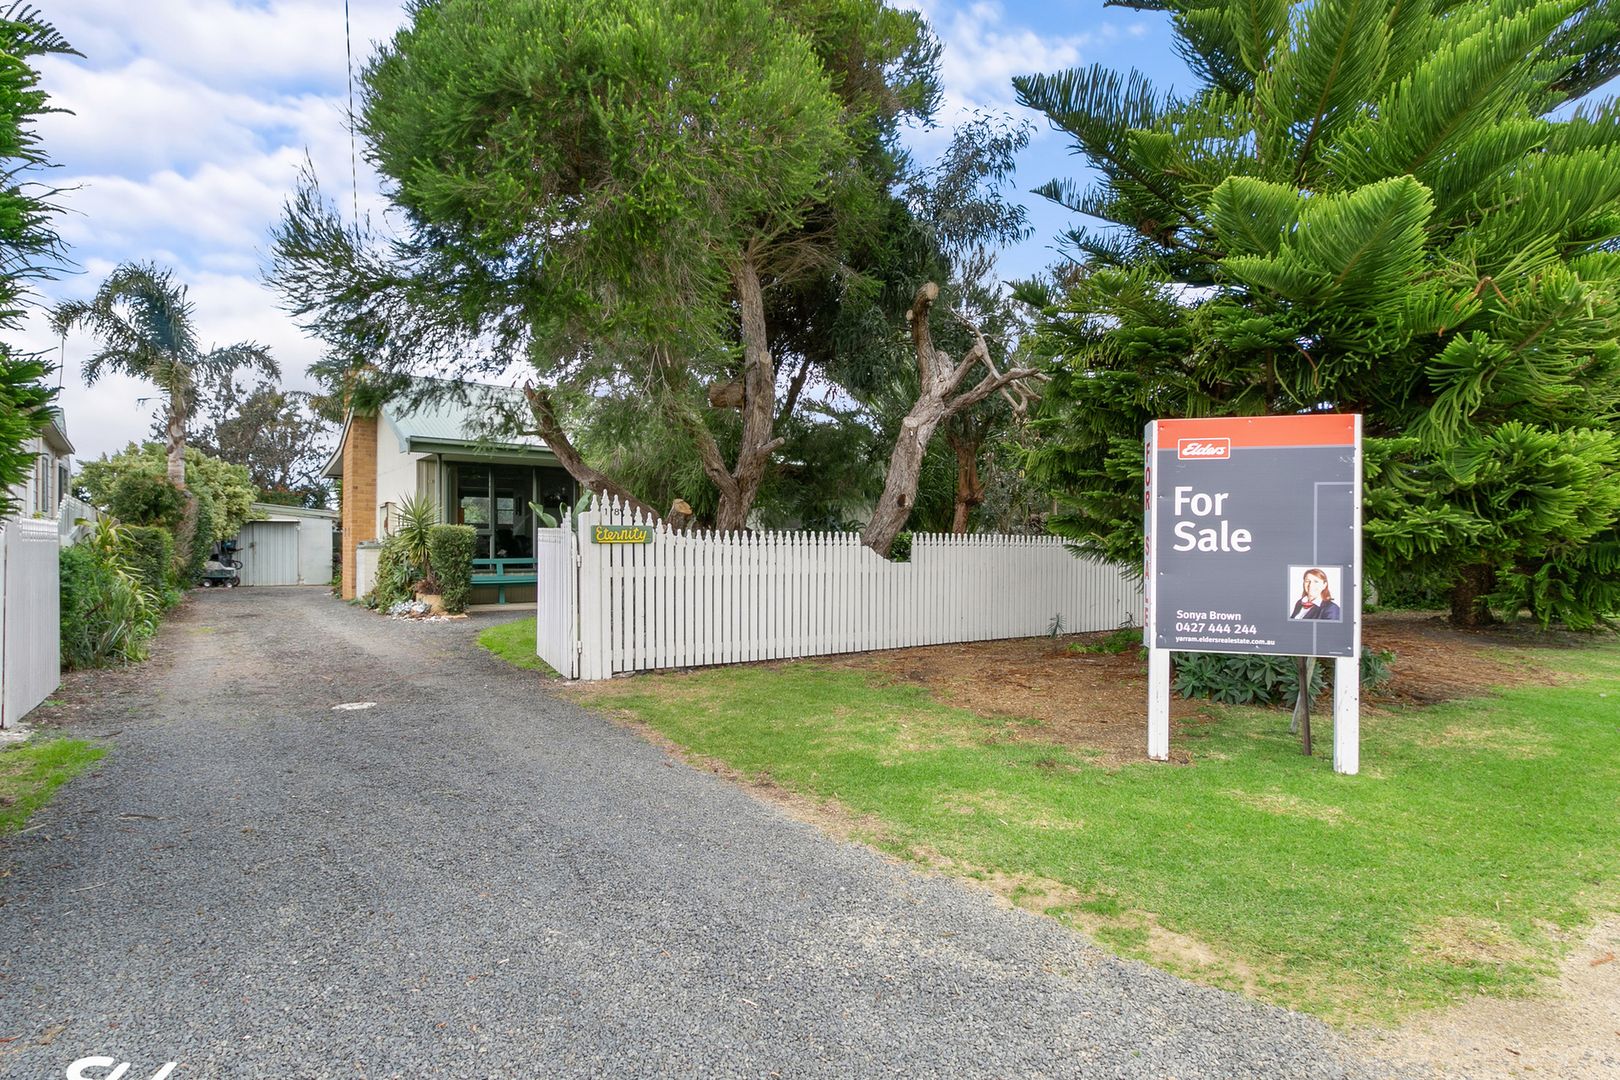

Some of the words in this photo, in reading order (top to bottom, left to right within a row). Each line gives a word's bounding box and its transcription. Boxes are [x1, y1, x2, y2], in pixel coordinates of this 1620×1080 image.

[1181, 443, 1227, 456] Elders
[1174, 486, 1229, 516] For
[604, 507, 620, 516] 18
[596, 526, 647, 541] Eternity
[1173, 520, 1252, 552] Sale
[1176, 609, 1207, 622] Sonya
[1209, 610, 1242, 621] Brown
[1175, 622, 1206, 633] 0427
[1208, 623, 1231, 634] 444
[1234, 624, 1257, 635] 244
[1175, 636, 1276, 646] yarram.eldersrealestate.com.au
